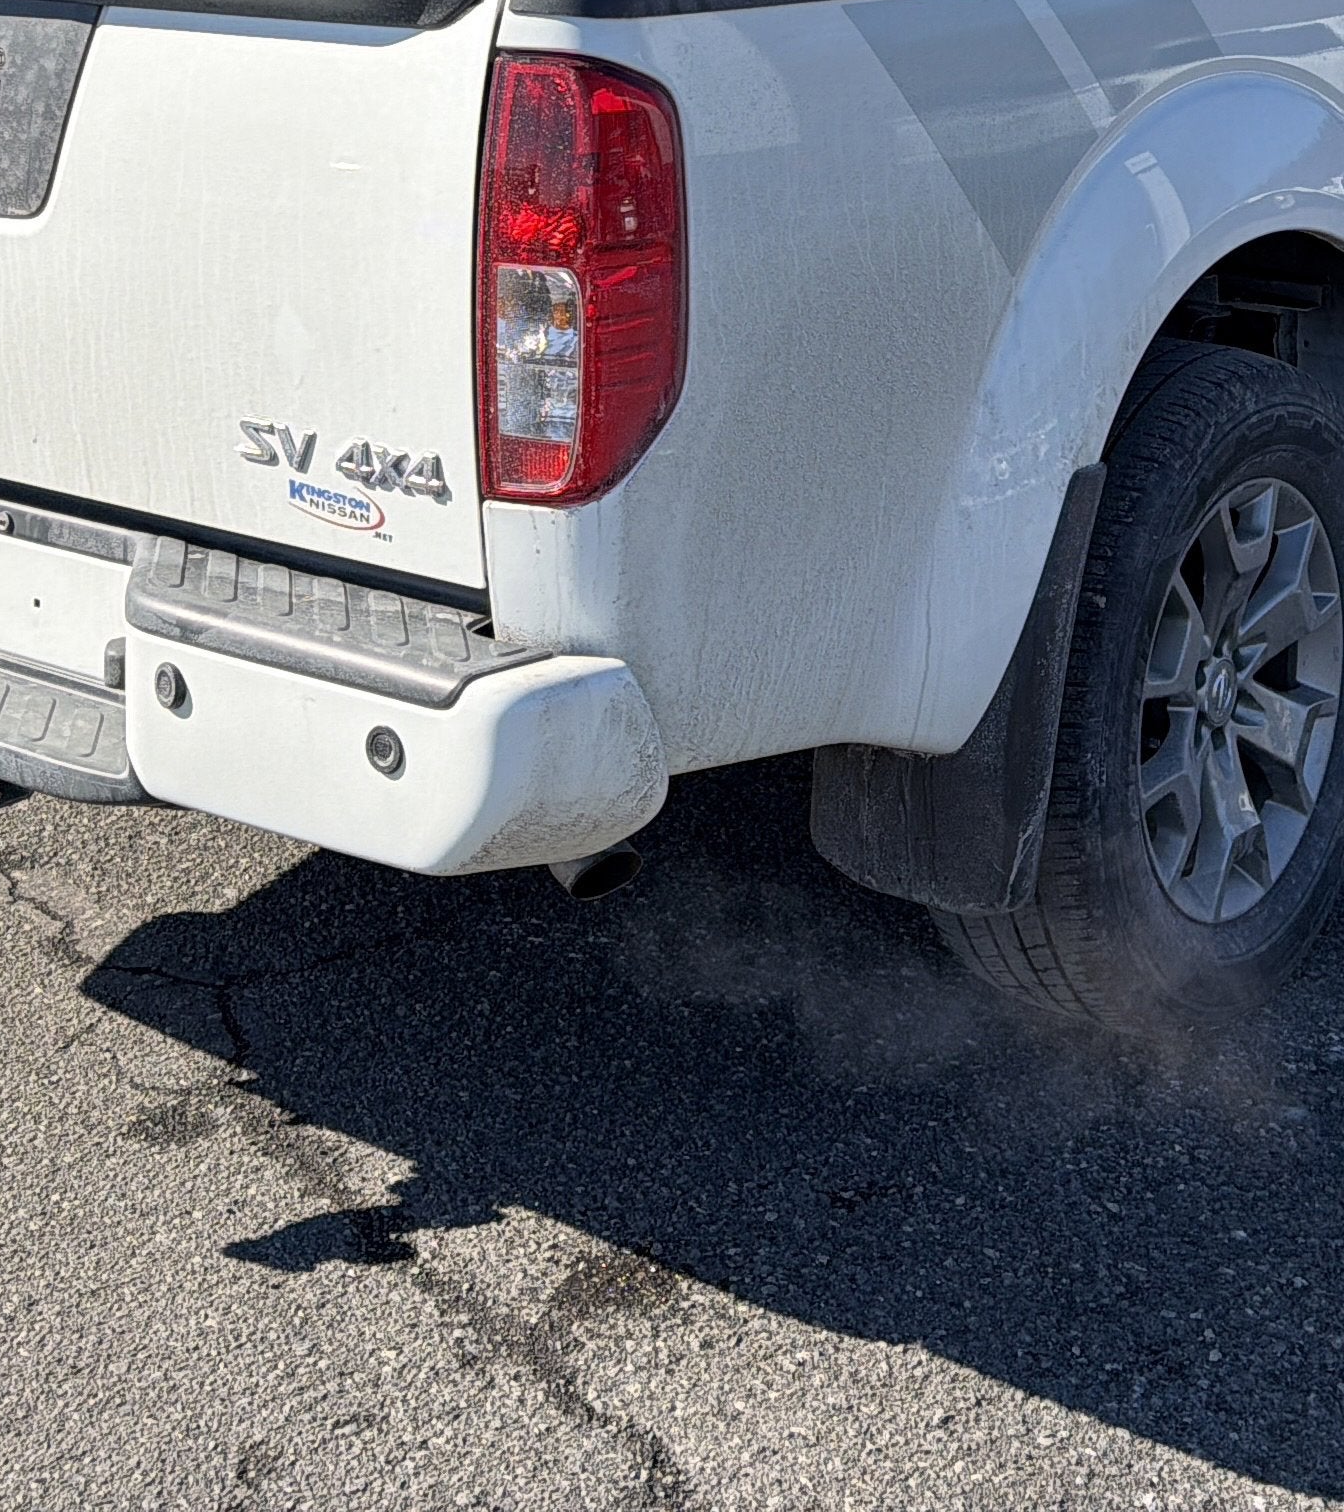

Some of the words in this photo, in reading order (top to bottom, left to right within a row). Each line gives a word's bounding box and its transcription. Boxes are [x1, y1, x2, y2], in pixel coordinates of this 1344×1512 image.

[233, 415, 318, 474] SV
[335, 436, 452, 504] 4X4
[288, 478, 371, 513] KINGSTON
[308, 497, 371, 525] NISSAN
